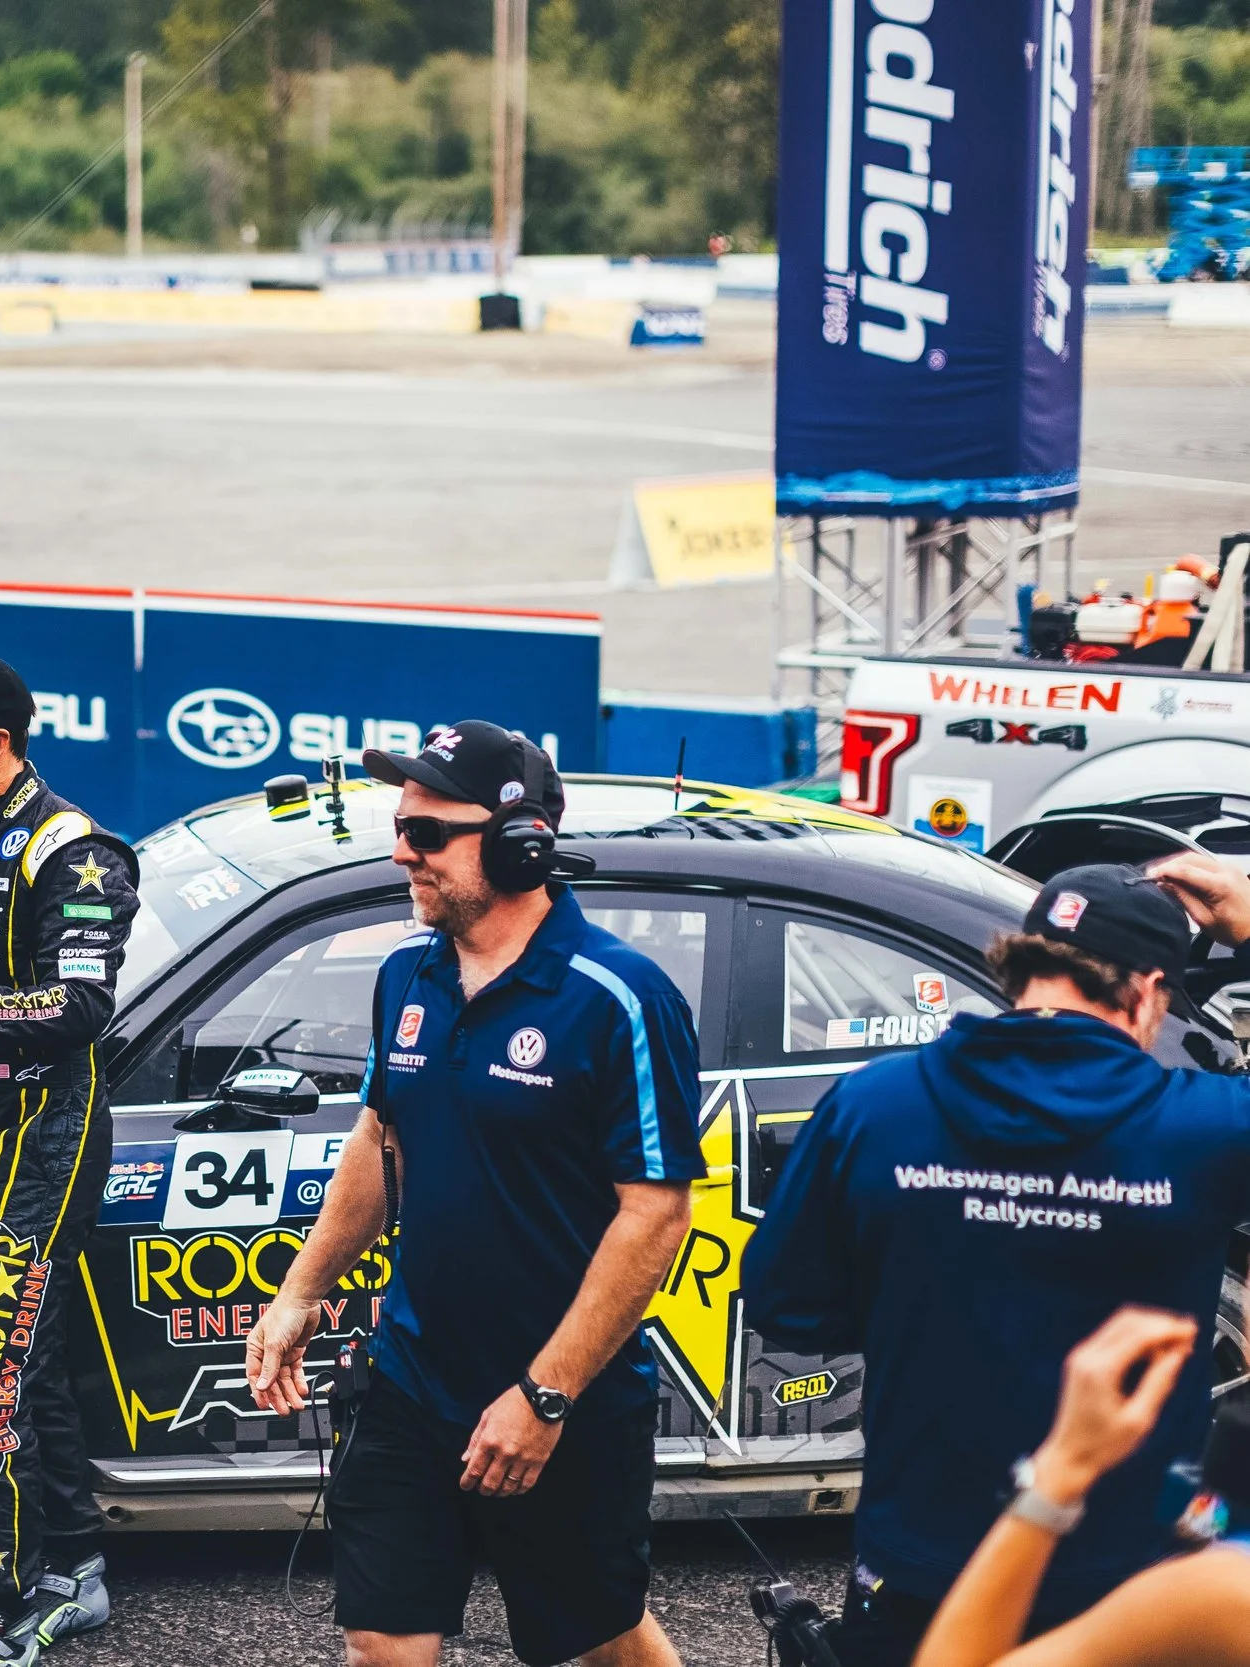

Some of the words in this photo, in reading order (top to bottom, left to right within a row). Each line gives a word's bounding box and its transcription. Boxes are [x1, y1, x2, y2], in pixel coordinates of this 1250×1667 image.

[928, 671, 1125, 714] WHELEN
[62, 963, 101, 973] SIEMENS
[27, 1005, 61, 1019] DRINK
[867, 1013, 952, 1047] FOUST
[241, 1073, 289, 1082] SIEMENS
[489, 1062, 554, 1088] Motorsport
[184, 1148, 274, 1210] 34
[894, 1163, 1055, 1197] Volkswagen
[1058, 1171, 1173, 1206] Andretti
[963, 1195, 1103, 1231] Rallycross
[9, 1261, 49, 1348] DRINK
[171, 1298, 349, 1340] ENEY
[783, 1375, 828, 1402] RS01
